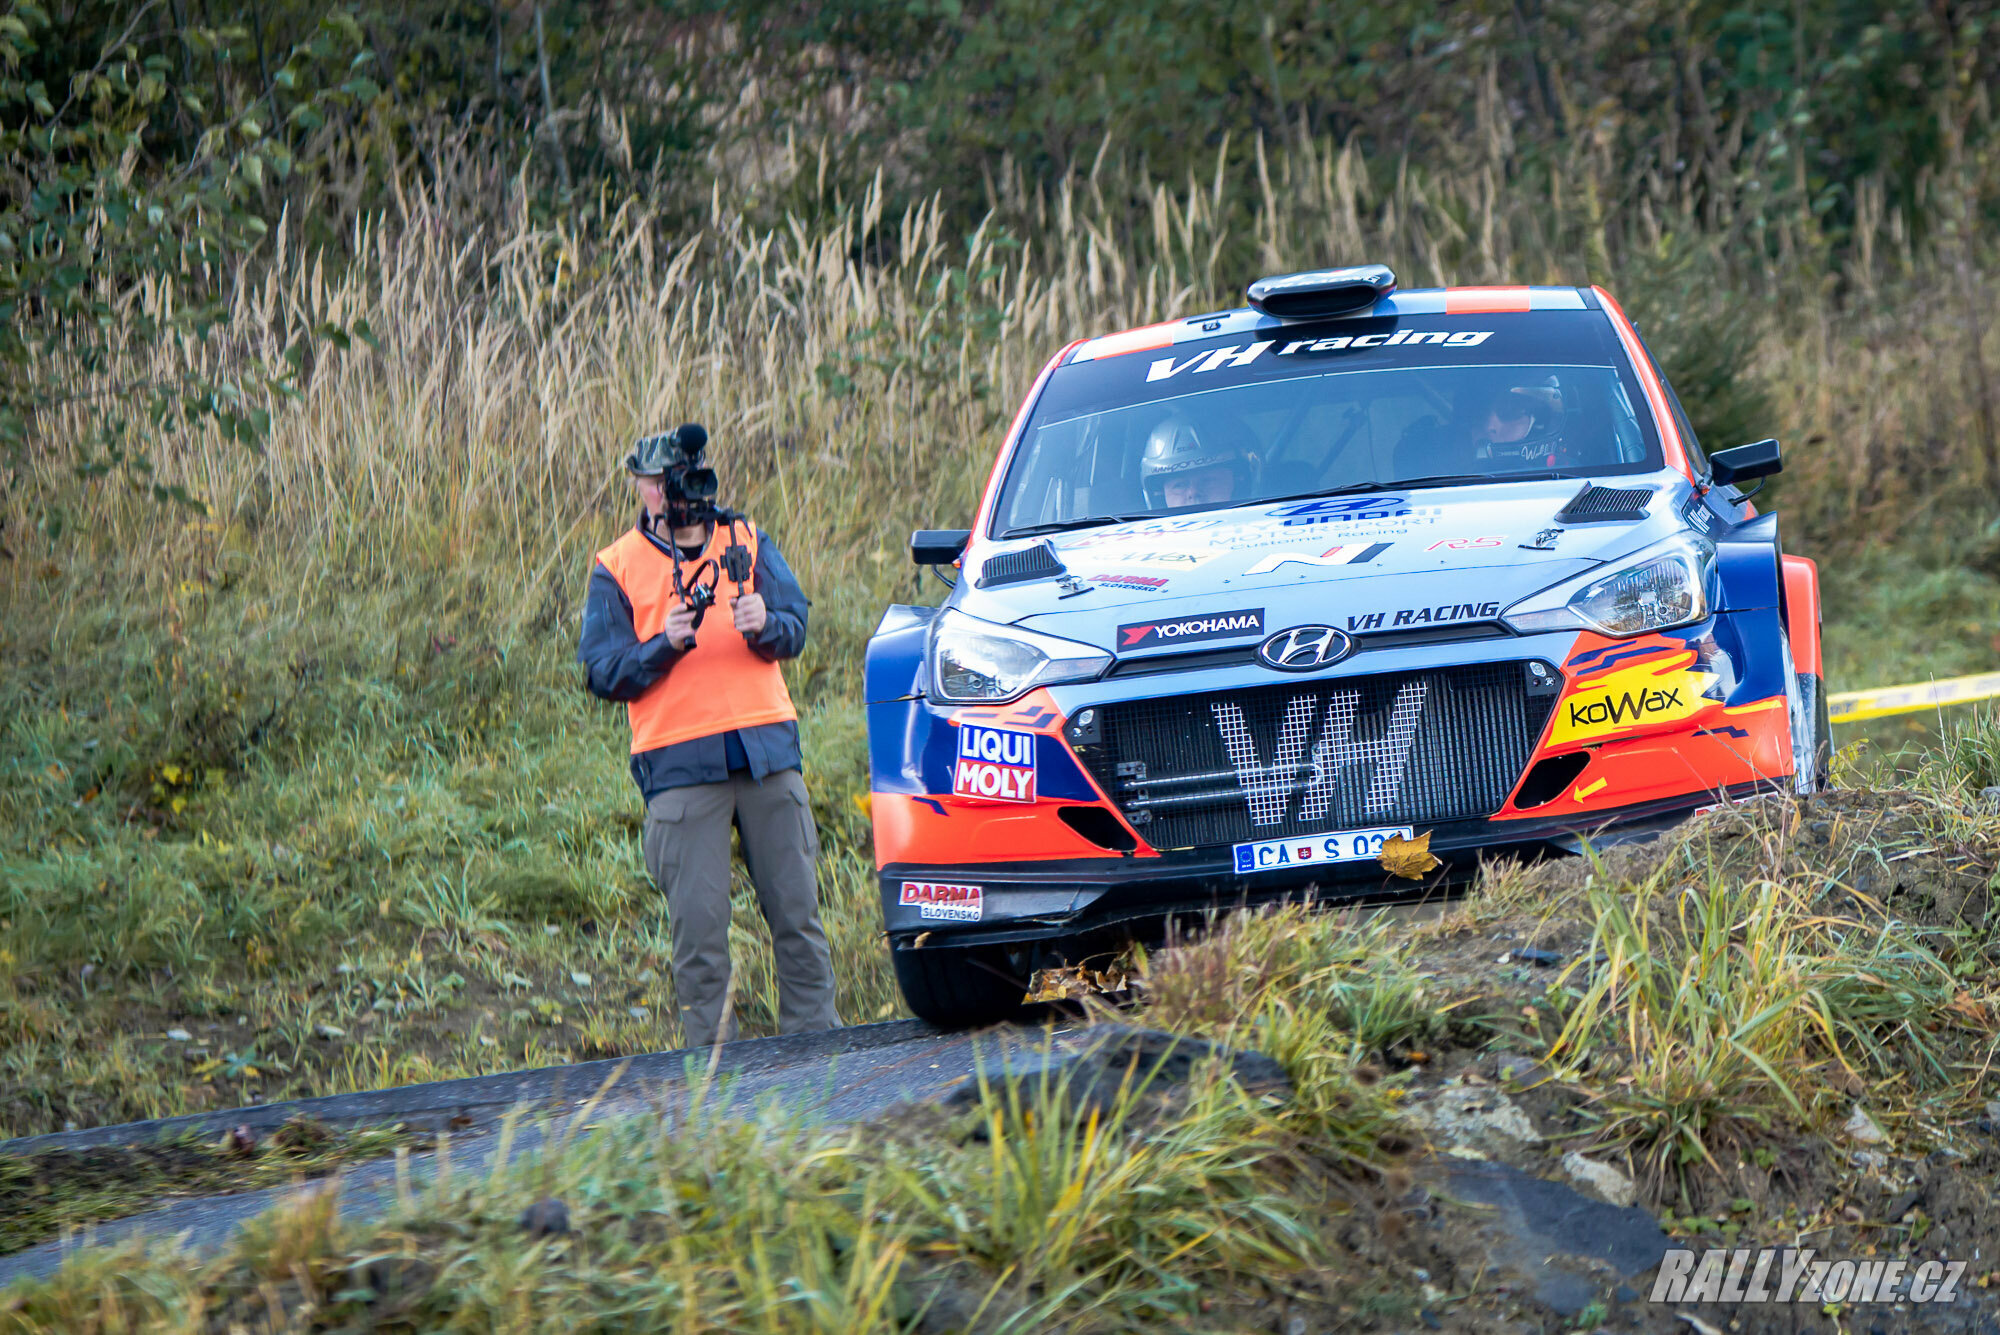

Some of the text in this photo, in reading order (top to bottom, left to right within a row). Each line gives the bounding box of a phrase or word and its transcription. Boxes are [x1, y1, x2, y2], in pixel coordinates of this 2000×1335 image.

[1145, 329, 1495, 383] VH racing
[1209, 516, 1443, 547] MOTORSPORT
[1087, 574, 1170, 588] DARMA
[1098, 582, 1158, 593] SLOVENSKO
[1154, 614, 1260, 640] YOKOHAMA
[1347, 602, 1500, 631] VH RACING
[1570, 687, 1684, 728] koWax
[961, 727, 1031, 764] LIQUI
[1211, 680, 1428, 827] VH
[956, 761, 1034, 800] MOLY
[1258, 832, 1399, 866] CA S 03
[902, 883, 980, 907] DARMA
[922, 907, 980, 921] SLOVENSKO
